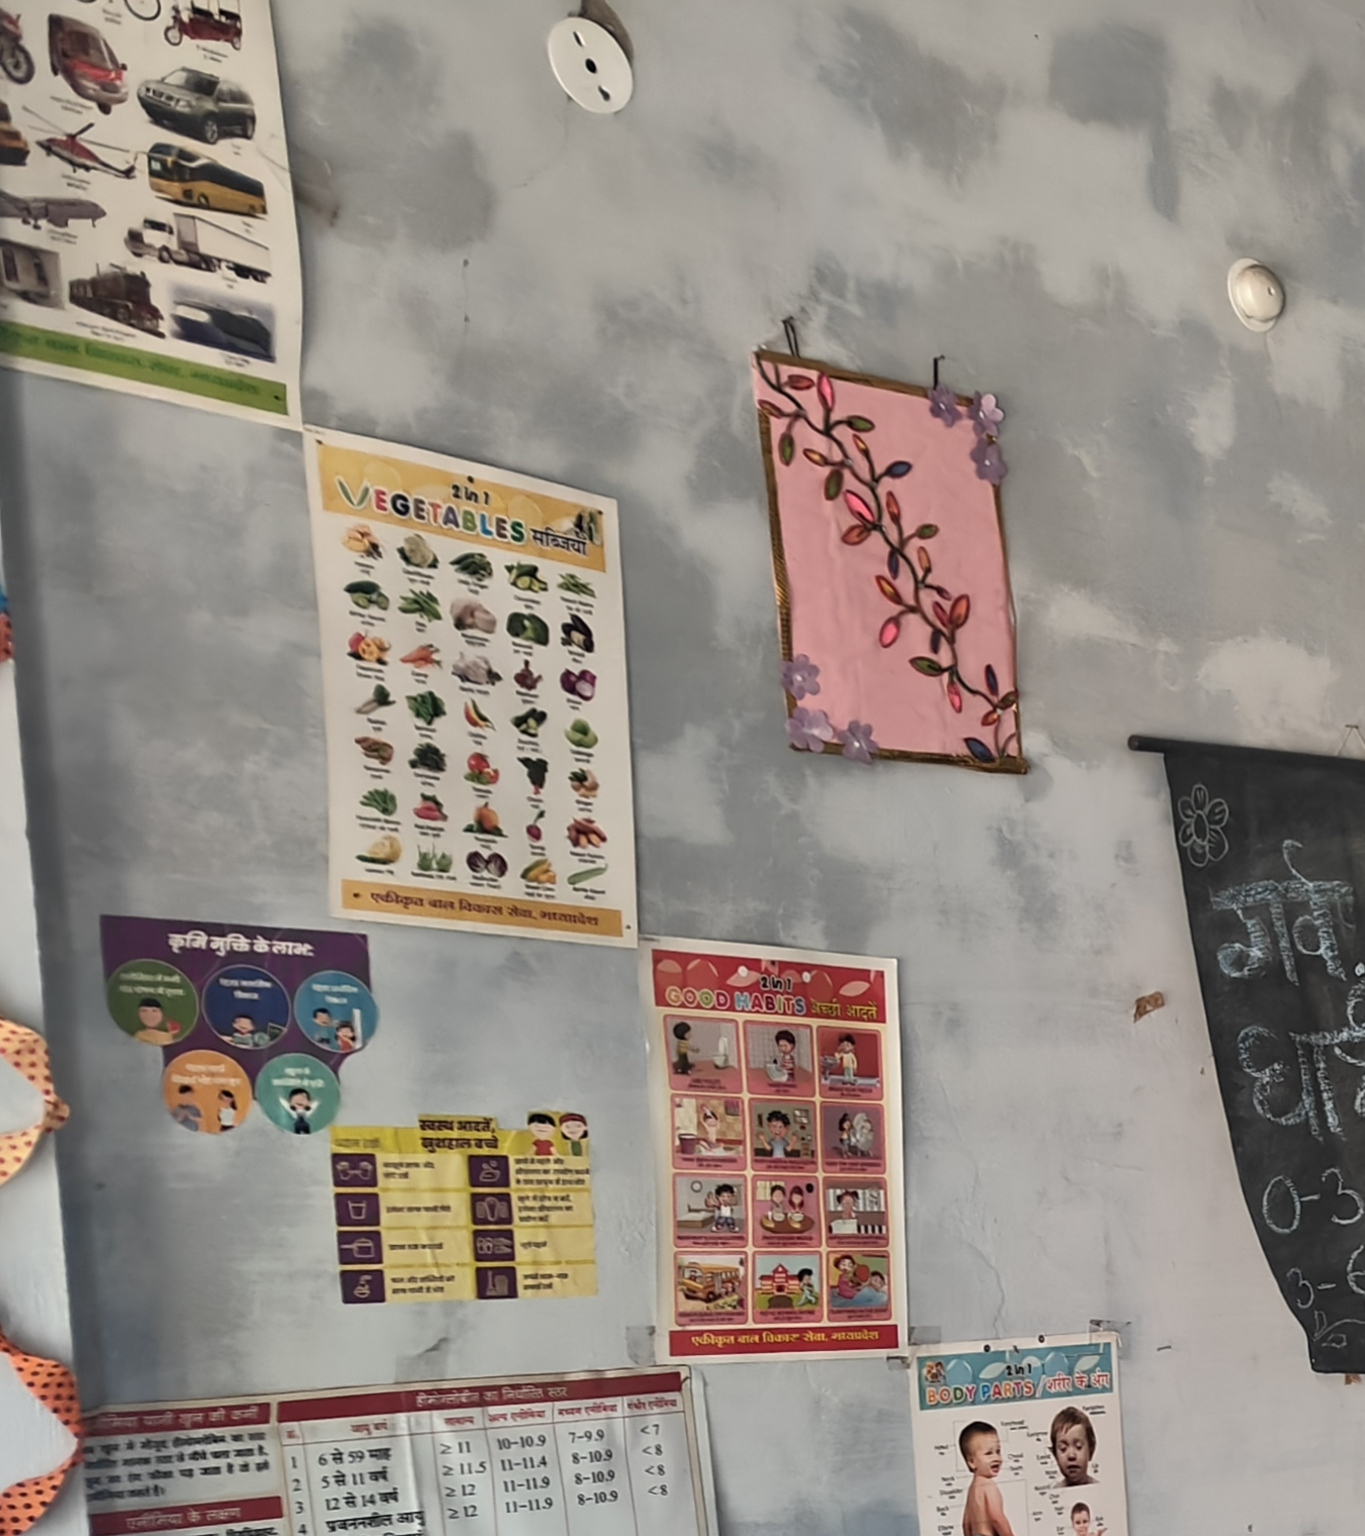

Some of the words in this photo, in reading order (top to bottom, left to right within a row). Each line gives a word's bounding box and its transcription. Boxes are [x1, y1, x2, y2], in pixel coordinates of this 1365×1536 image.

[335, 474, 527, 544] VEGETABLES
[371, 889, 424, 910] एकीकृत
[429, 897, 455, 912] बाल
[458, 898, 503, 917] विकास
[168, 930, 207, 954] कृमि
[210, 933, 250, 956] मुक्ति
[253, 935, 270, 955] के
[665, 986, 730, 1010] GOOD
[734, 991, 807, 1015] HABITS
[811, 997, 842, 1017] अच्छी
[846, 1001, 878, 1020] आदतें
[419, 1119, 455, 1132] स्वस्थ
[421, 1135, 472, 1153] खुशहाल
[475, 1134, 499, 1150] बच्चे
[691, 1332, 735, 1348] एकीकृत
[737, 1332, 760, 1343] बाल
[1075, 1372, 1088, 1391] के
[1091, 1368, 1111, 1389] अंग
[926, 1384, 977, 1405] BODY
[979, 1379, 1034, 1399] PARTS
[290, 1456, 298, 1469] 1
[318, 1452, 328, 1466] 6
[331, 1448, 344, 1465] से
[348, 1450, 365, 1464] 59
[457, 1440, 471, 1454] 11
[292, 1478, 302, 1492] 2
[321, 1475, 330, 1489] 5
[333, 1470, 346, 1487] से
[295, 1501, 304, 1514] 3
[326, 1497, 341, 1511] 12
[343, 1492, 358, 1509] से
[460, 1484, 476, 1497] 12
[187, 1507, 201, 1522] के
[463, 1505, 478, 1518] 12
